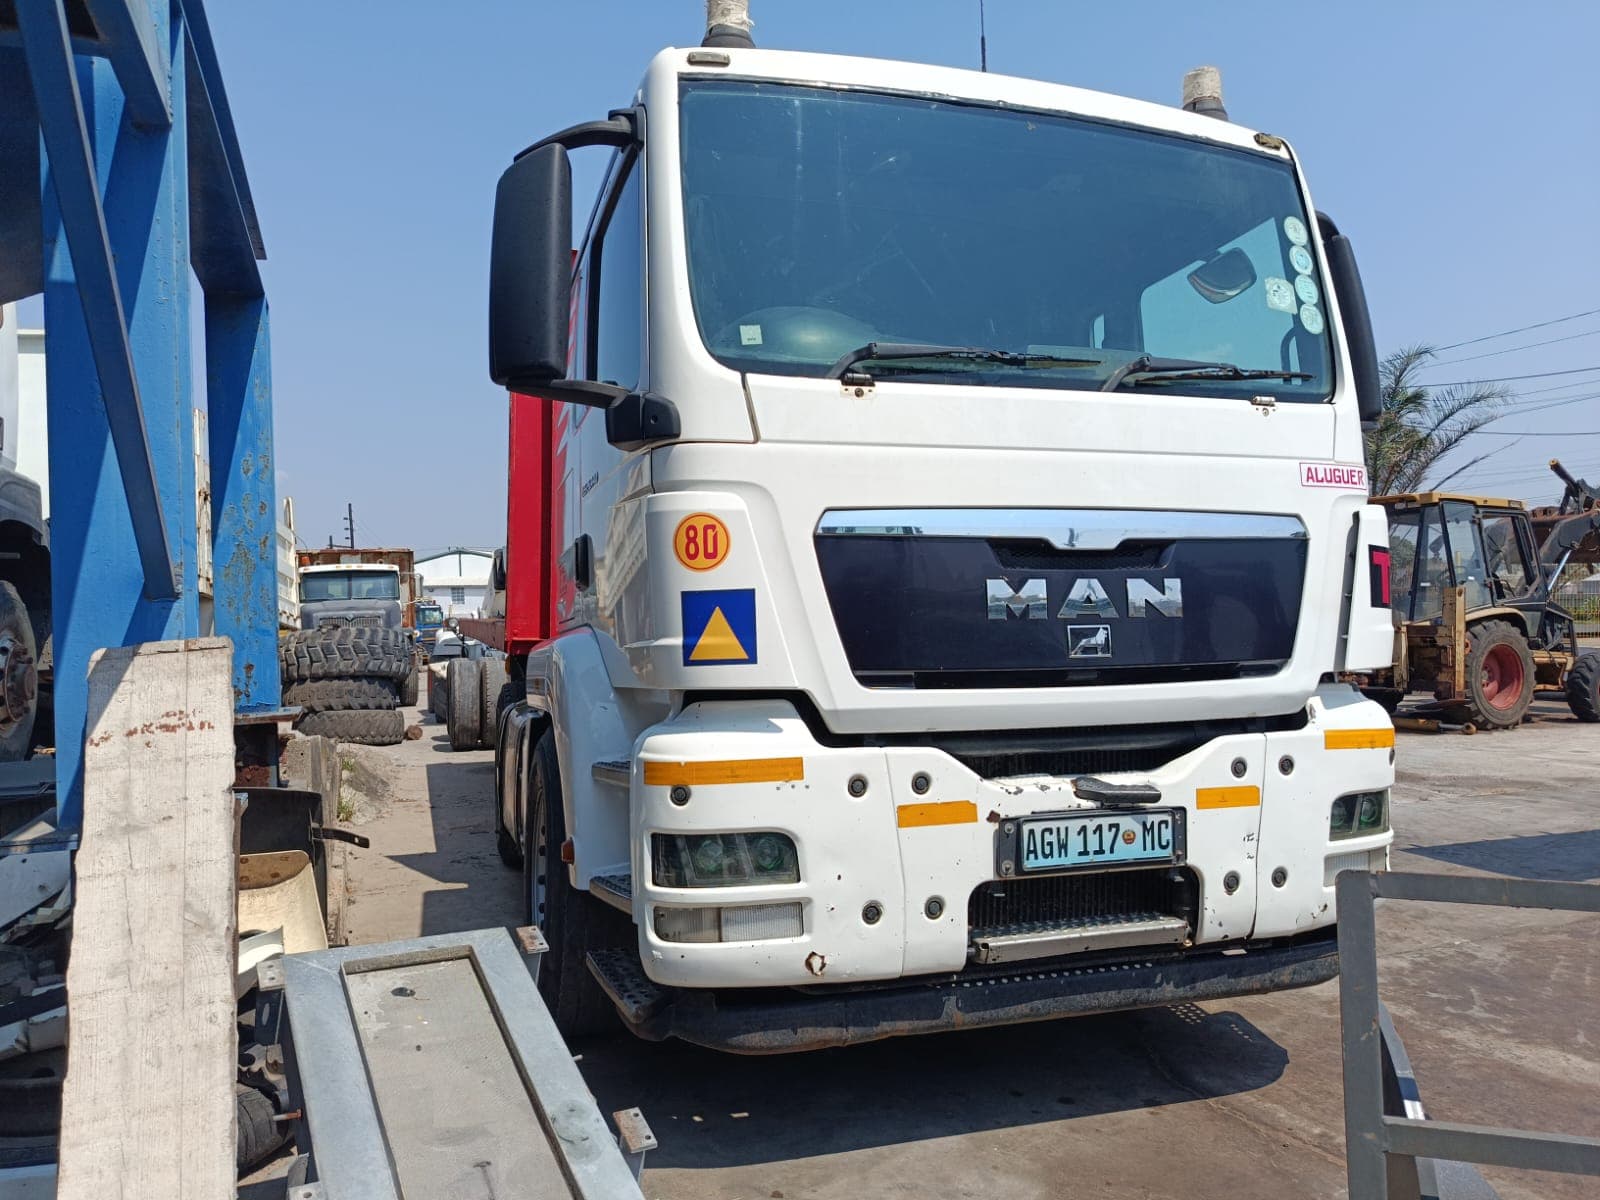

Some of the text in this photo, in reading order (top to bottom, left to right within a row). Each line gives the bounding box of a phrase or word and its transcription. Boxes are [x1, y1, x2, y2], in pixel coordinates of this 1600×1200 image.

[1305, 466, 1365, 486] ALUGUER
[684, 524, 719, 561] 80
[986, 577, 1184, 620] MAN
[1025, 819, 1170, 861] AGW 117 MC
